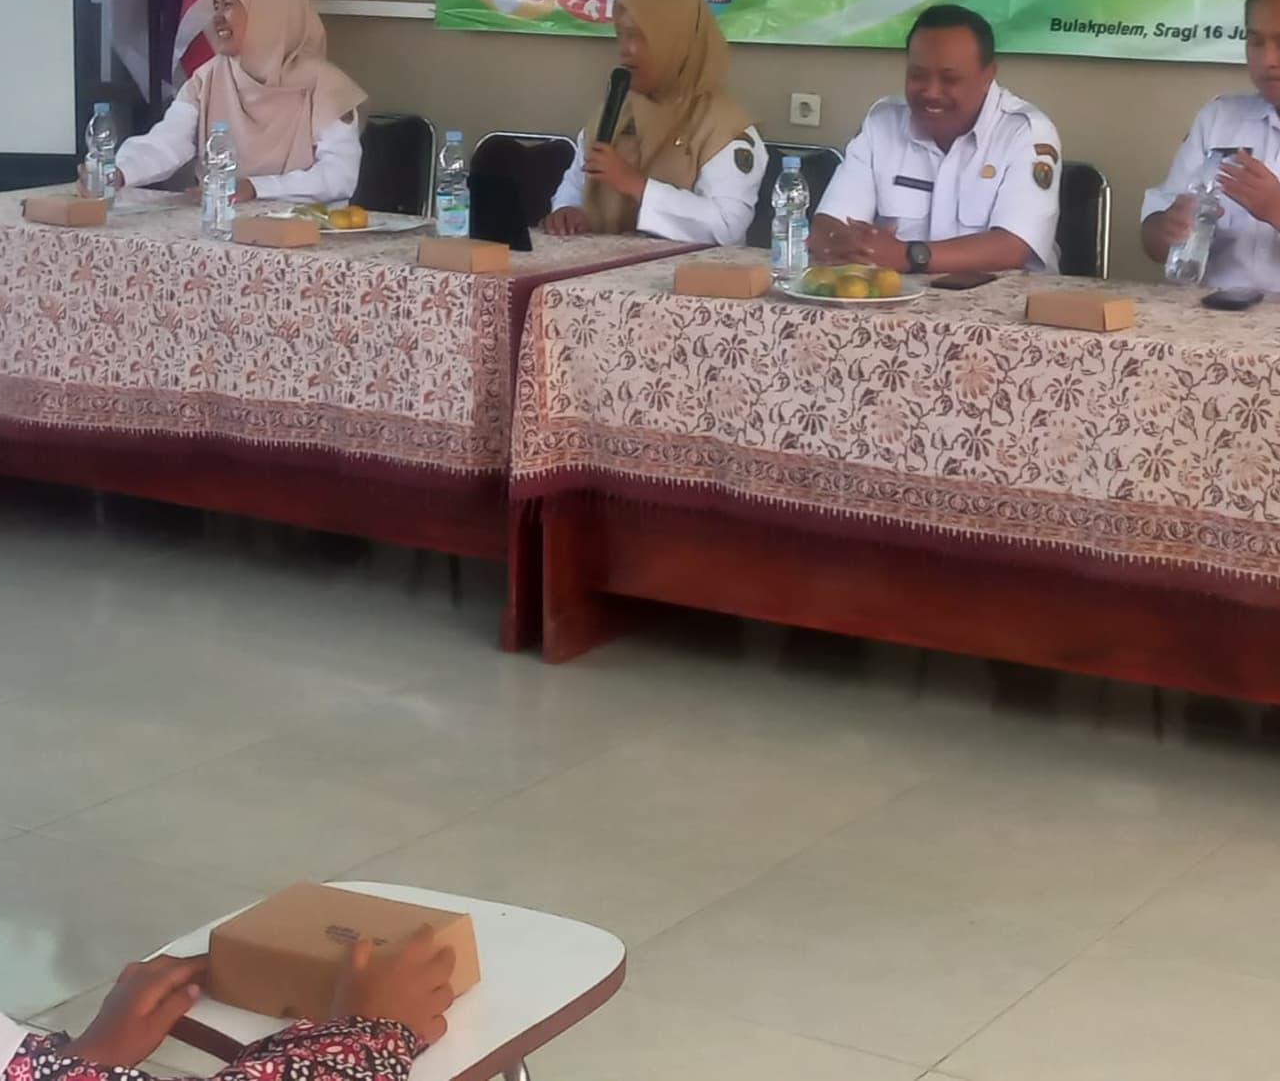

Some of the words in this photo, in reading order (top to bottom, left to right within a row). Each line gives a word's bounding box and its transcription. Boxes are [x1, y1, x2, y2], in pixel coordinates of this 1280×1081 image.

[1049, 17, 1148, 38] Bulakpelem,
[1153, 22, 1197, 42] Sragi
[1203, 25, 1223, 39] 16
[1227, 26, 1248, 40] Ju
